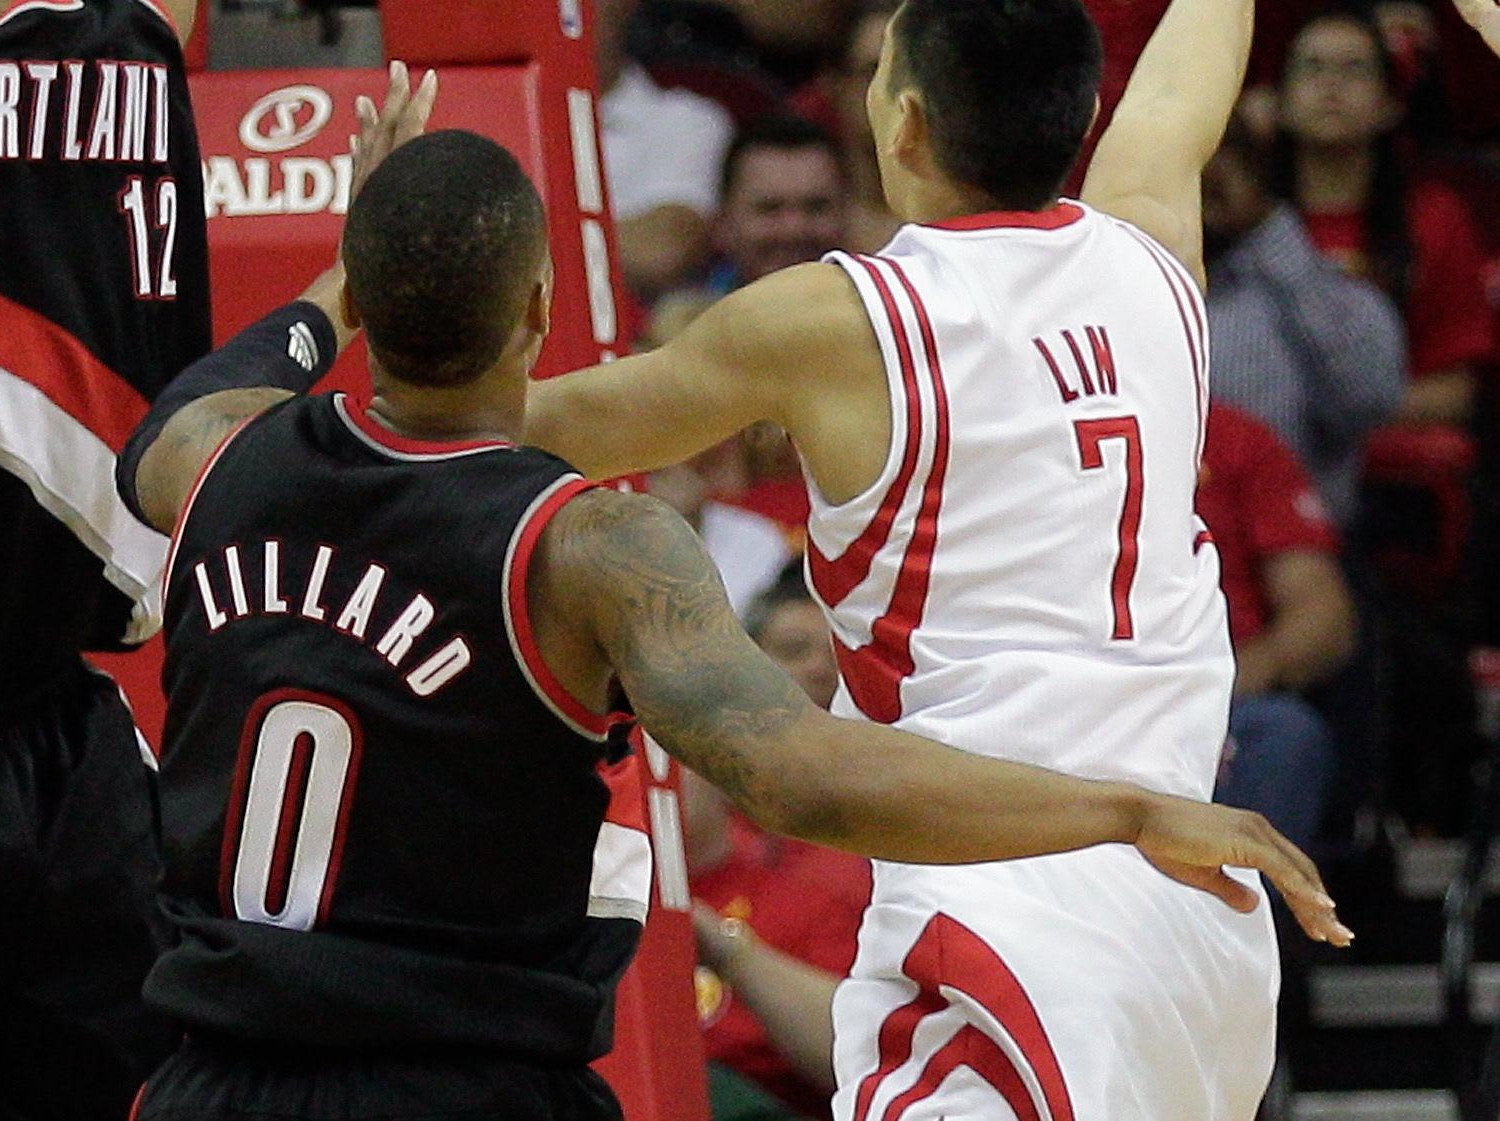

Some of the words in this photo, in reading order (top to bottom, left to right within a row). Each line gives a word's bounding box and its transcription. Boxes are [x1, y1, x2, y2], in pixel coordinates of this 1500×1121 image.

[120, 176, 177, 300] 12
[202, 152, 354, 218] ALDI
[1032, 325, 1117, 403] LIN
[1072, 414, 1144, 641] 7
[193, 538, 472, 698] LILLARD
[222, 688, 362, 933] 0
